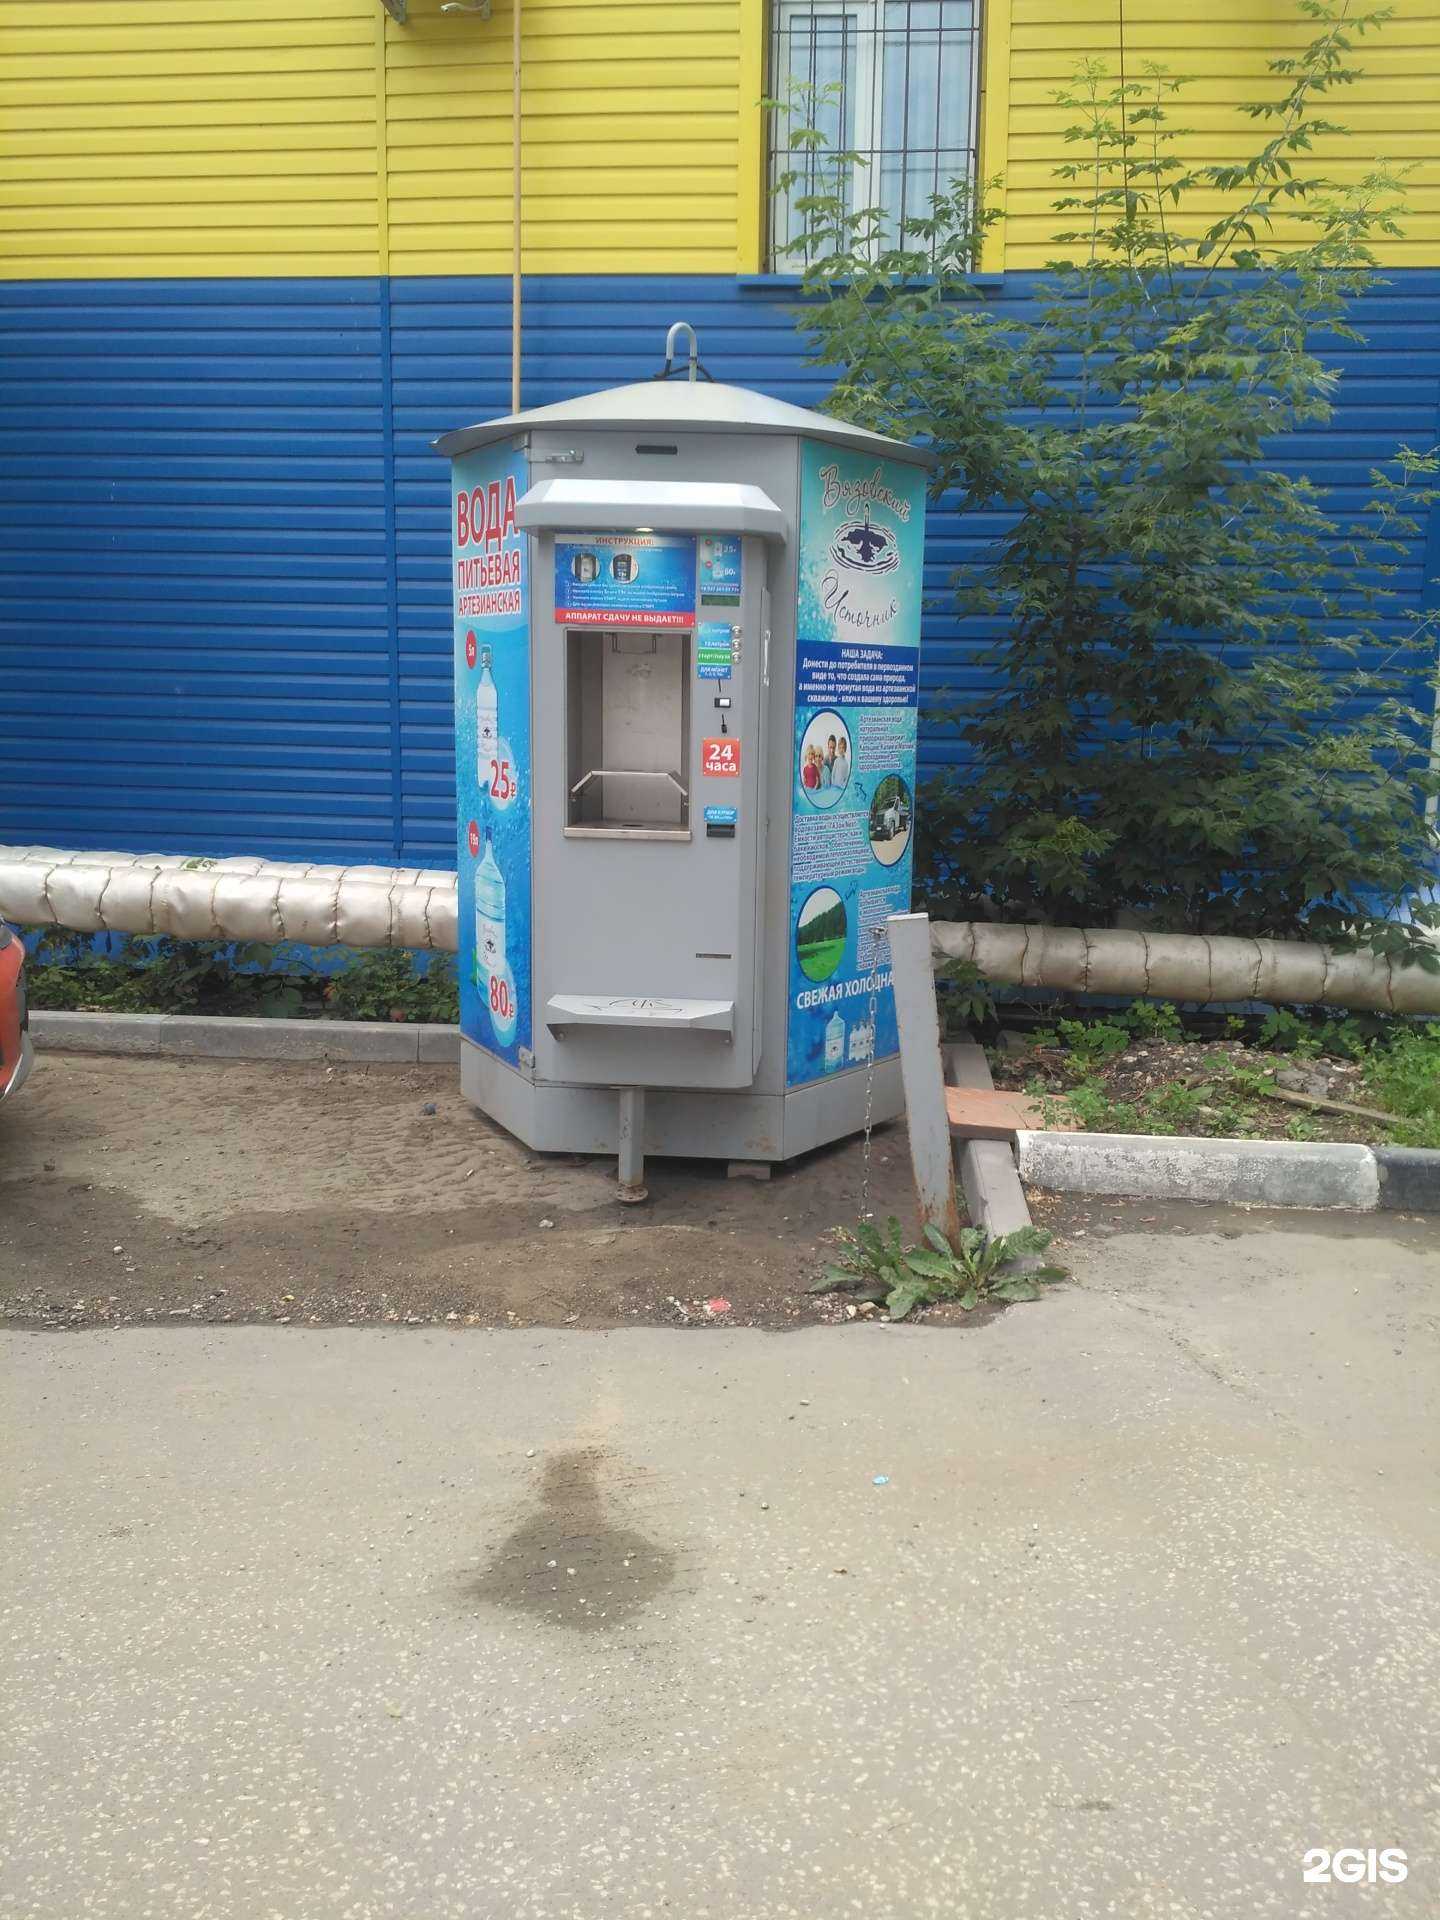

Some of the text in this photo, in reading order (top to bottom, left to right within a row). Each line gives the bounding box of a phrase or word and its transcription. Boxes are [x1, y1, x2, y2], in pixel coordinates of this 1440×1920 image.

[457, 477, 519, 552] ВОДА
[458, 551, 520, 589] ПИТЬЕВАЯ
[459, 590, 520, 616] АРТЕЗИАНСКАЯ
[821, 569, 897, 628] Источник
[565, 612, 601, 620] АППАРАТ
[603, 612, 630, 622] СДАЧУ
[643, 614, 684, 624] ВЫДАЕТ!!!
[841, 648, 884, 660] НАША ЗАДАЧА:
[802, 658, 829, 670] Донести
[829, 661, 837, 670] до
[812, 672, 827, 681] виде
[827, 683, 835, 691] не
[709, 744, 733, 760] 24
[705, 761, 736, 771] часа
[797, 984, 843, 1009] СВЕЖАЯ
